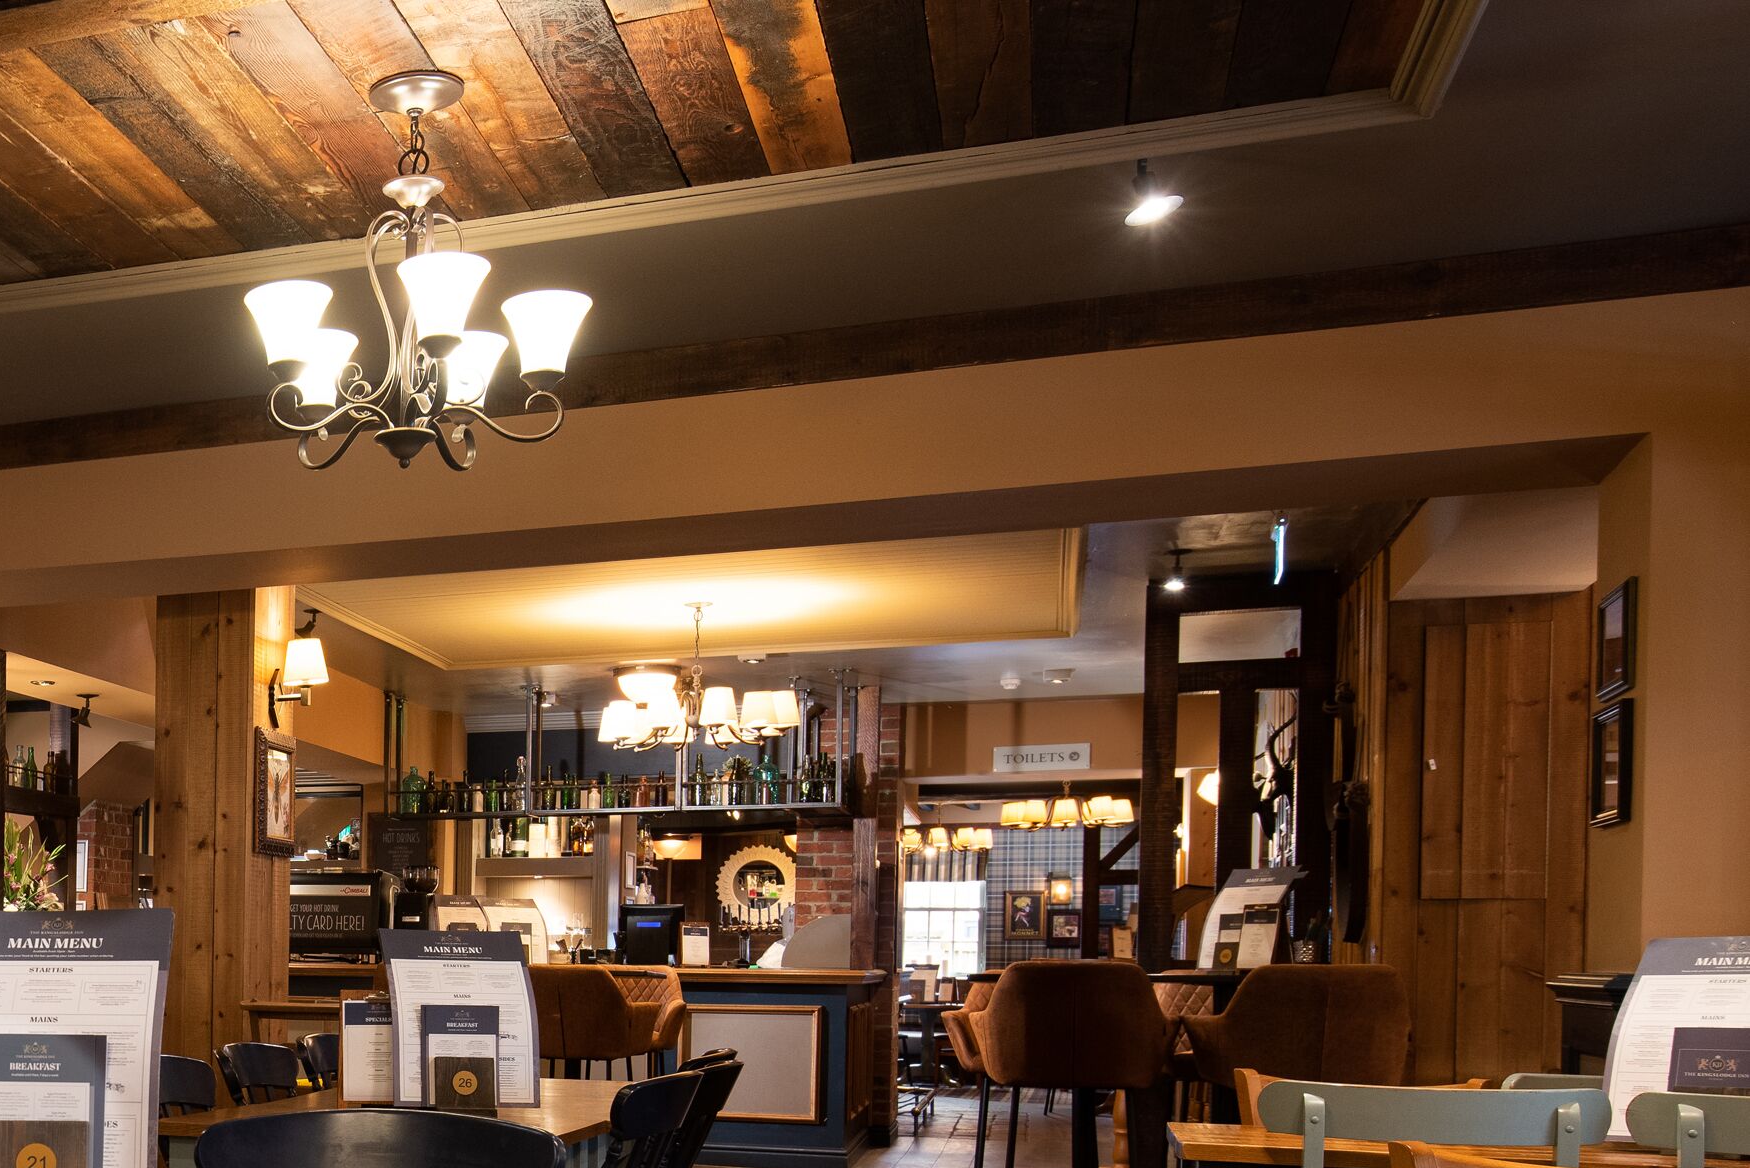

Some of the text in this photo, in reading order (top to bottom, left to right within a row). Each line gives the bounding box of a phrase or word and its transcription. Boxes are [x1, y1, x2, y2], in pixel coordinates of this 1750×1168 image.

[1003, 752, 1065, 764] TOILETS
[300, 903, 312, 912] YOUR
[313, 903, 323, 912] HOT
[323, 903, 340, 913] DRINK
[306, 915, 333, 931] CARD
[335, 915, 365, 931] HERE!
[7, 938, 104, 949] MAIN MENU
[452, 946, 483, 954] MENU
[1695, 957, 1734, 966] MAIN
[9, 1062, 61, 1071] BREAKFAST
[458, 1077, 472, 1088] 26
